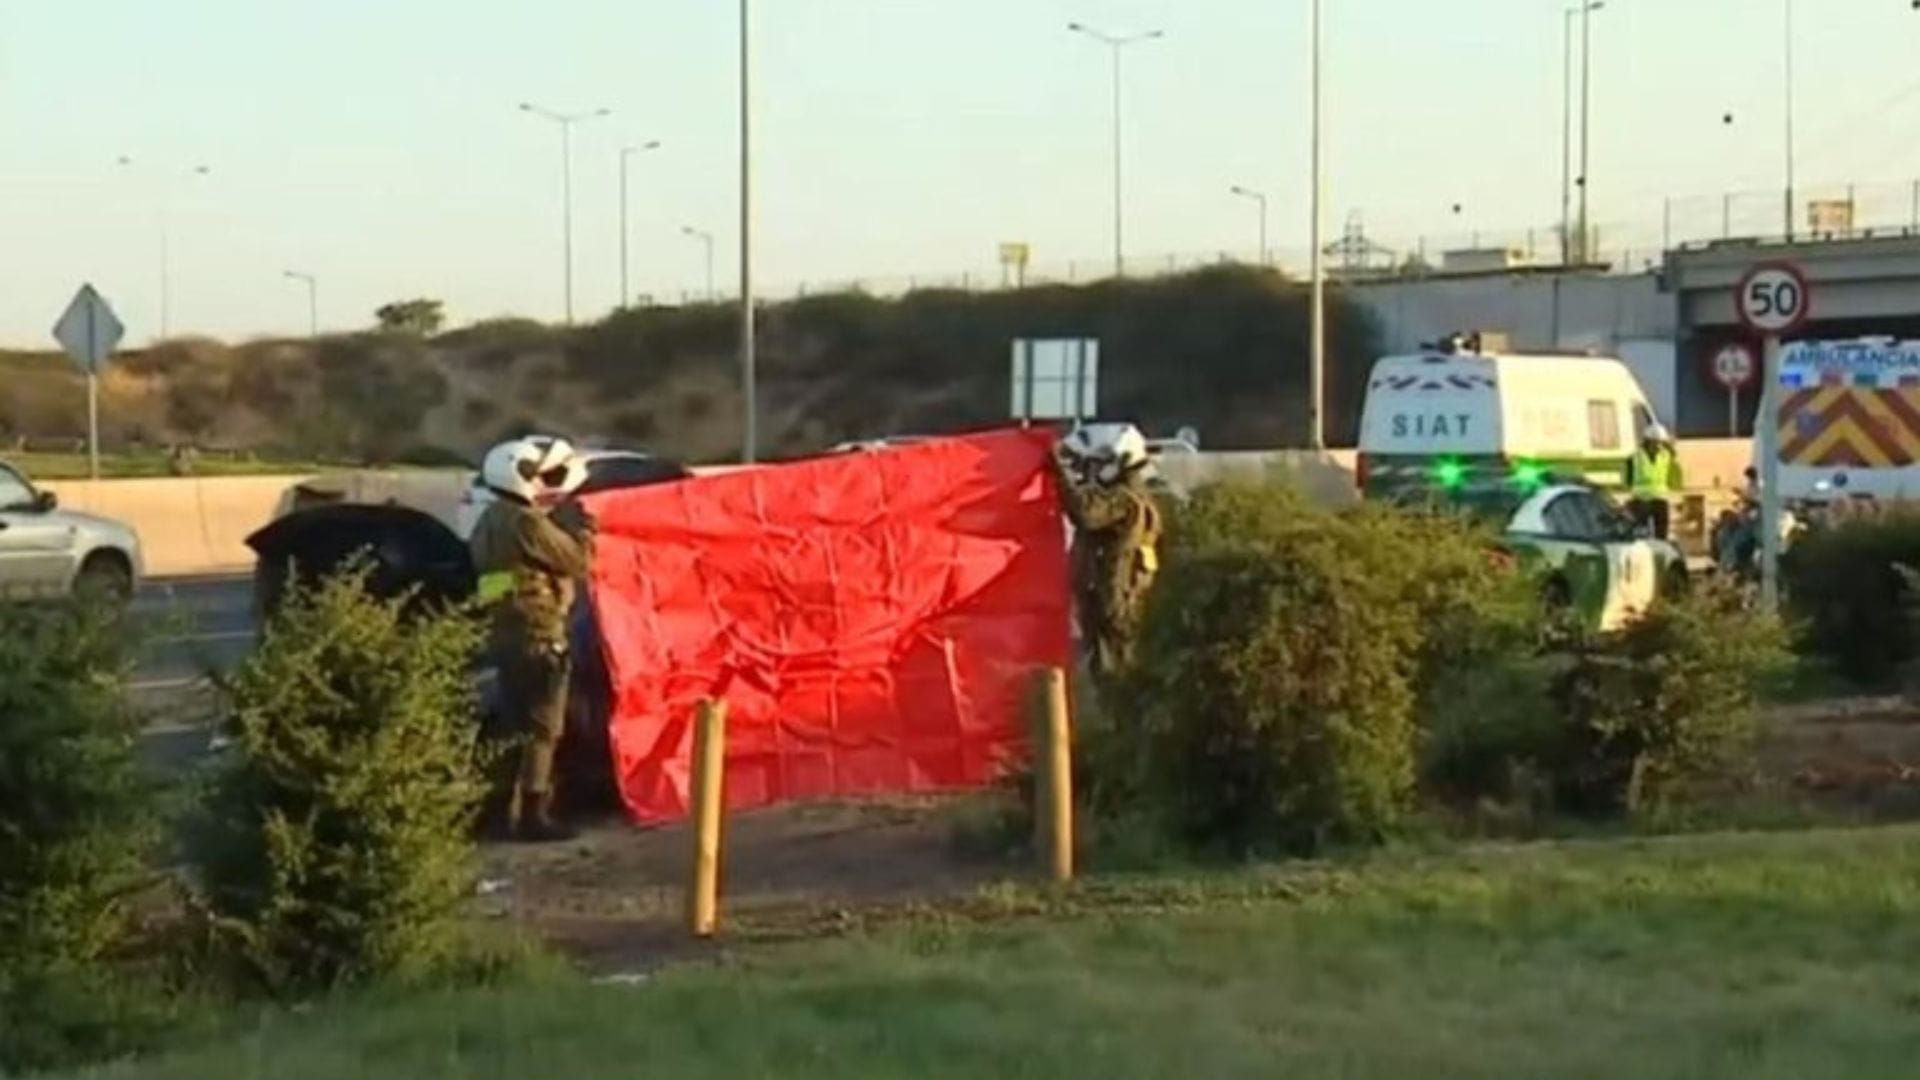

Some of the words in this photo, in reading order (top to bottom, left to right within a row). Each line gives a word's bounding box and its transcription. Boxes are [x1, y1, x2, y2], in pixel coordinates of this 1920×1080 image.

[1751, 282, 1798, 317] 50
[1784, 348, 1919, 366] AMBULANCIA
[1392, 413, 1471, 438] SIAT
